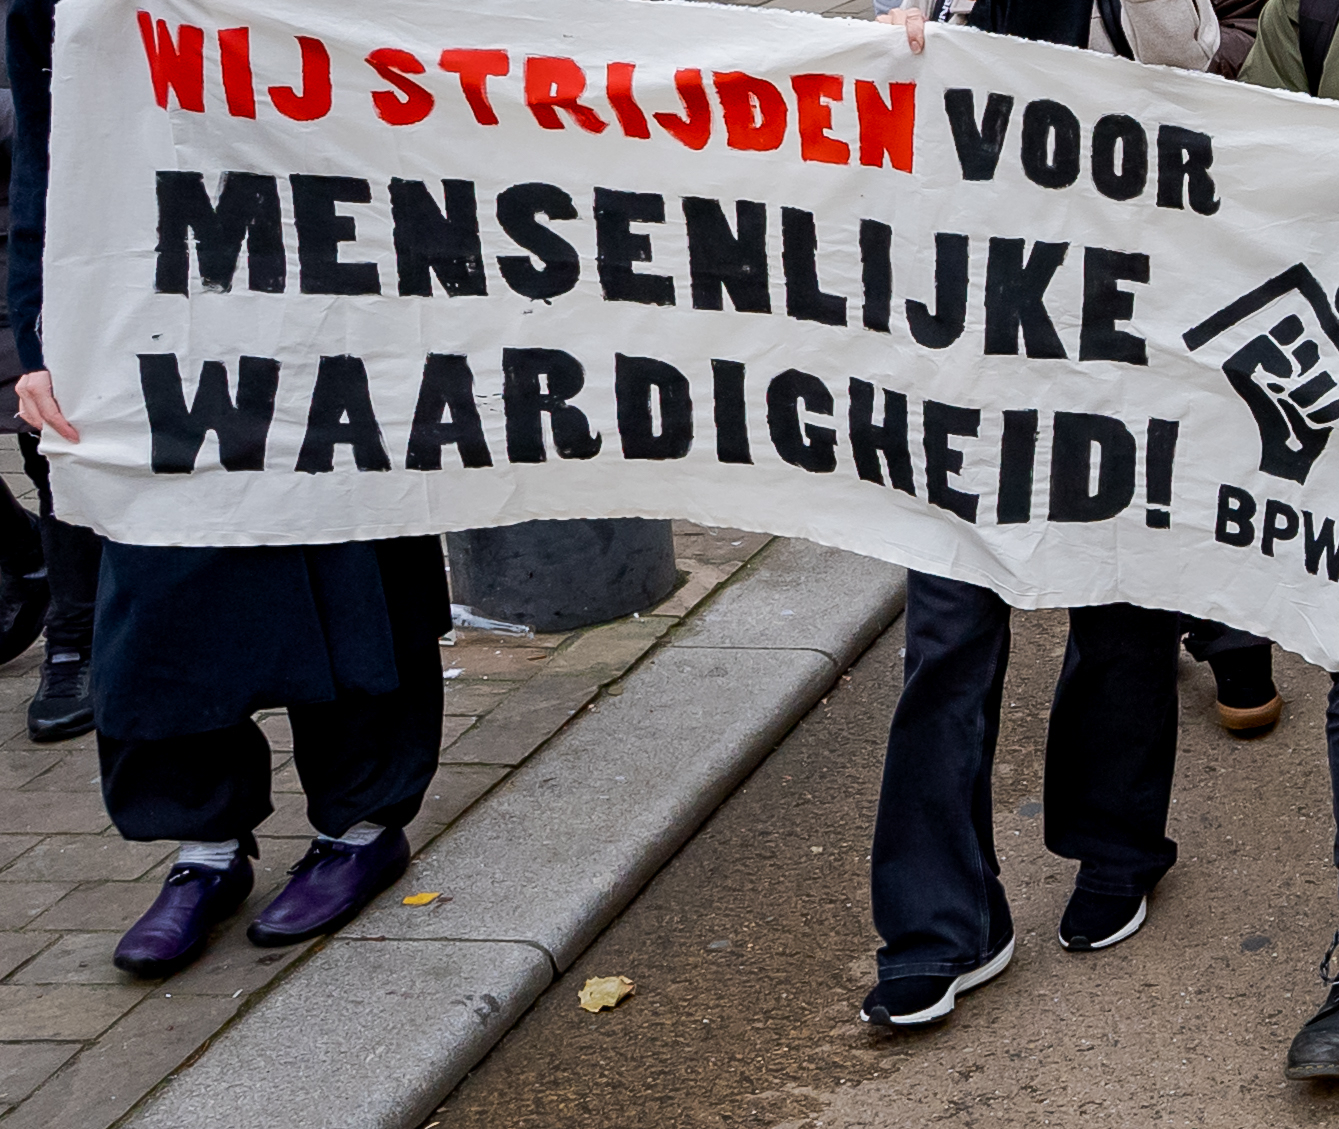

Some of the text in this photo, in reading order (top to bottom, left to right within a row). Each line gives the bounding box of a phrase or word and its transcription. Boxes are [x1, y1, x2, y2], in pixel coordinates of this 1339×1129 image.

[137, 9, 1221, 217] WIJ STRIJDEN VOOR
[154, 170, 1150, 367] MENSENLIJKE
[136, 347, 1179, 531] WAARDIGHEID!
